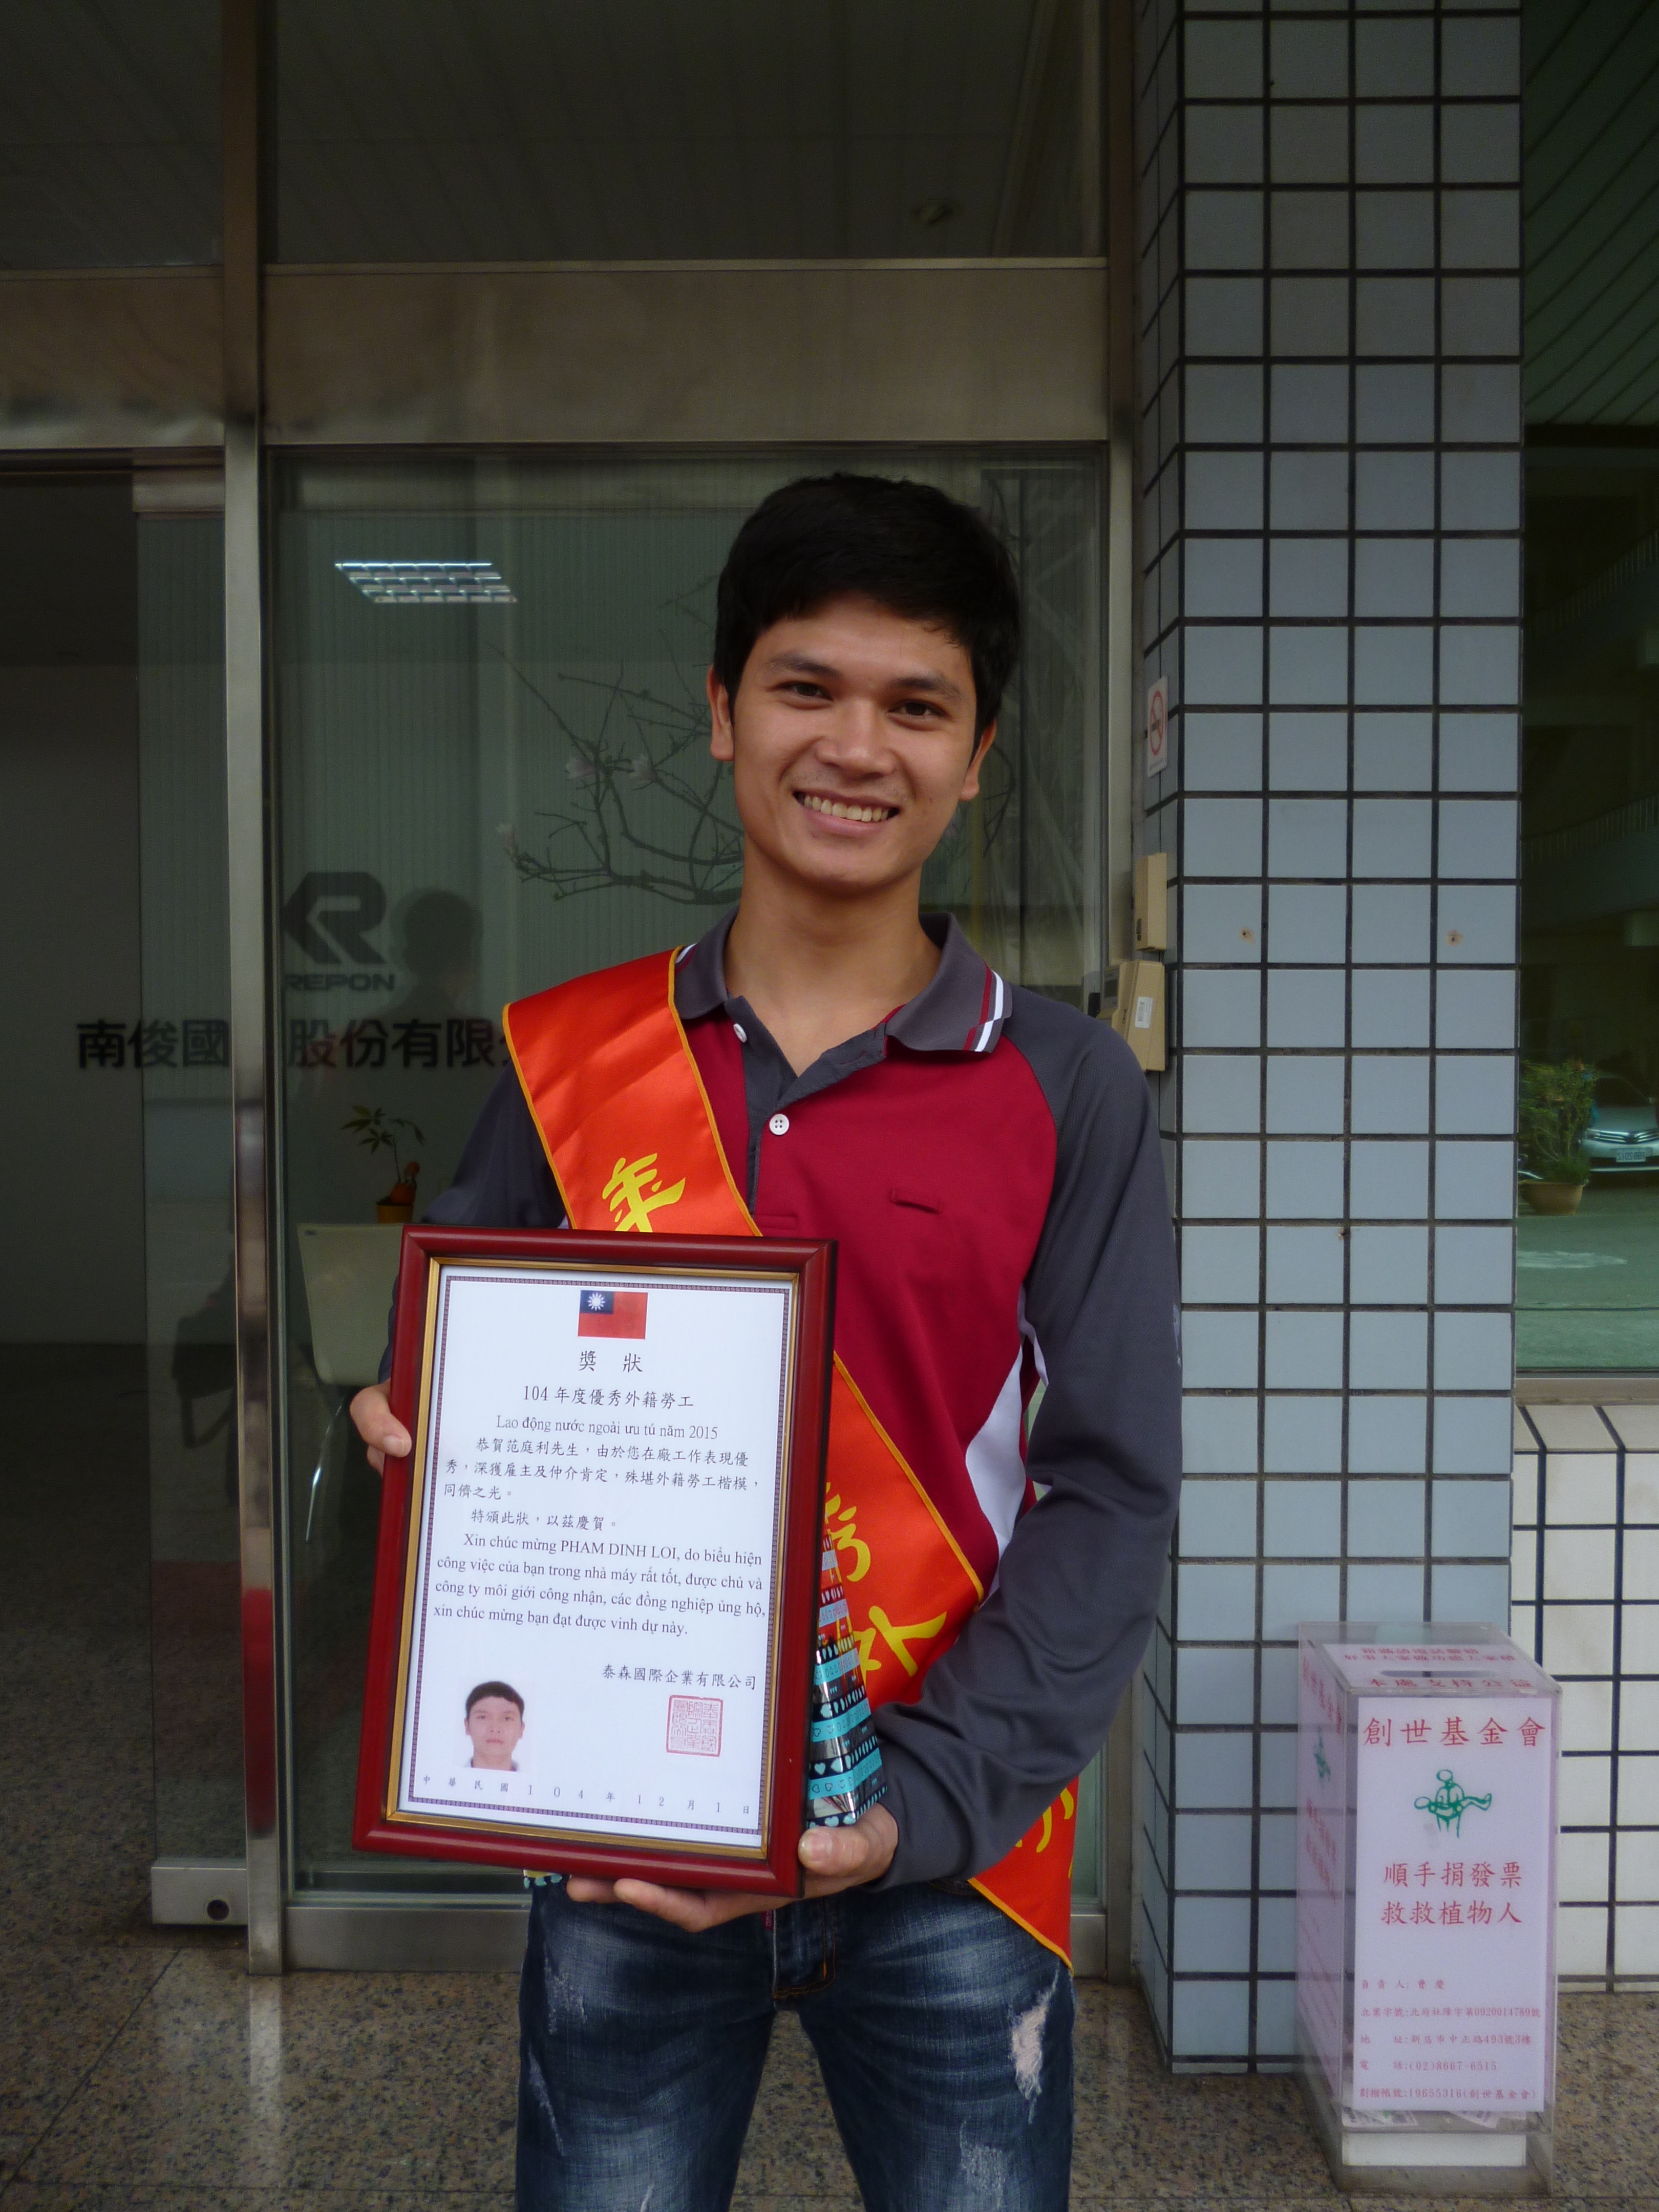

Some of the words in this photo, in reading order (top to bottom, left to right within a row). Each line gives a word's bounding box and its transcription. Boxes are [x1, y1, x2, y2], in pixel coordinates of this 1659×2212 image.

[285, 973, 395, 992] REPON
[496, 1415, 519, 1429] Lao
[522, 1417, 551, 1432] động
[555, 1419, 585, 1432] nước
[588, 1420, 621, 1436] ngoài
[625, 1423, 640, 1435] ưu
[644, 1423, 655, 1436] tú
[660, 1425, 685, 1438] năm
[689, 1426, 718, 1439] 2015
[444, 1484, 512, 1500] 同儕之光。
[463, 1534, 486, 1547] Xin
[490, 1536, 518, 1548] chúc
[522, 1539, 557, 1554] mừng
[560, 1540, 604, 1555] PHAM
[608, 1543, 646, 1557] DINH
[651, 1546, 680, 1561] LOI,
[685, 1548, 699, 1561] do
[704, 1547, 731, 1563] biểu
[735, 1551, 761, 1568] hiện
[437, 1557, 466, 1572] công
[471, 1558, 495, 1573] việc
[498, 1560, 519, 1573] của
[524, 1562, 544, 1577] bạn
[549, 1565, 581, 1580] trong
[585, 1566, 606, 1579] nhà
[611, 1568, 637, 1584] máy
[641, 1567, 657, 1583] rất
[662, 1568, 681, 1586] tốt,
[685, 1573, 717, 1588] được
[721, 1576, 743, 1588] chủ
[748, 1578, 762, 1589] và
[435, 1580, 464, 1596] công
[469, 1584, 480, 1597] ty
[484, 1584, 507, 1597] môi
[512, 1586, 535, 1600] giới
[540, 1588, 569, 1604] công
[573, 1590, 606, 1605] nhận,
[611, 1592, 631, 1605] các
[636, 1591, 667, 1611] đồng
[671, 1598, 714, 1614] nghiệp
[718, 1600, 741, 1616] ủng
[746, 1602, 765, 1617] hộ,
[434, 1604, 452, 1617] xin
[456, 1606, 485, 1619] chúc
[489, 1609, 523, 1625] mừng
[527, 1610, 548, 1626] bạn
[553, 1613, 571, 1626] đạt
[576, 1614, 606, 1630] được
[611, 1618, 637, 1630] vinh
[642, 1619, 658, 1634] dự
[662, 1621, 688, 1637] này.
[603, 1664, 756, 1690] 泰森國際企業有限公司
[1363, 1716, 1546, 1747] 創世基金會
[1382, 1860, 1523, 1889] 順手捐發票
[1380, 1899, 1523, 1926] 救救植物人
